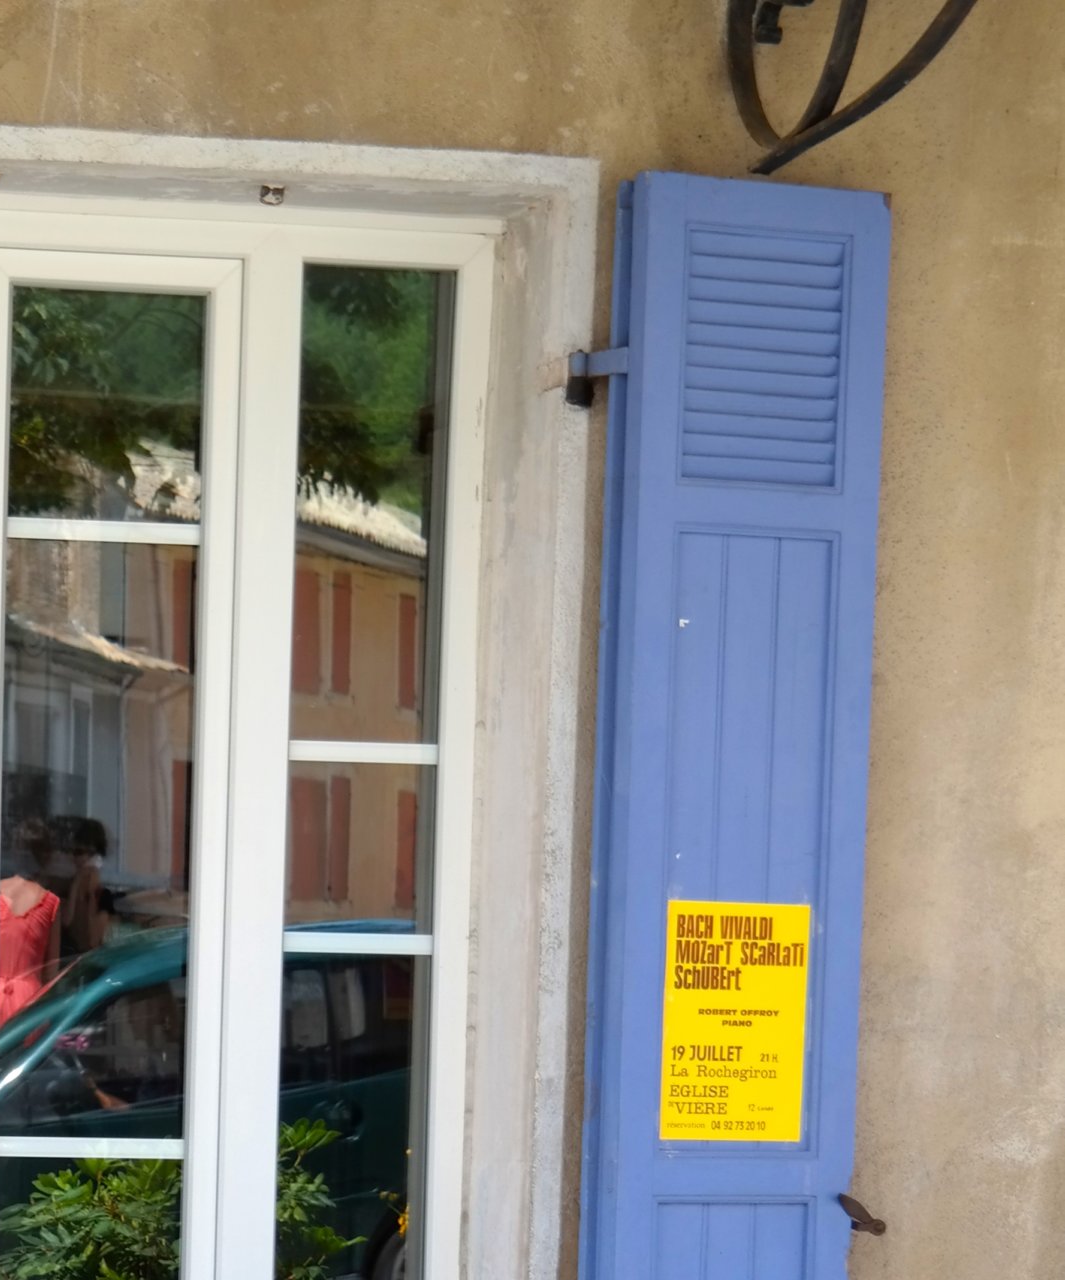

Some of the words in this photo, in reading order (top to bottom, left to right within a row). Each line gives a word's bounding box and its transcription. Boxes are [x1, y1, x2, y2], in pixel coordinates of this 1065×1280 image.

[677, 914, 714, 939] BACH
[720, 915, 773, 941] VIVALDI
[698, 1008, 738, 1016] ROBERT
[740, 1009, 779, 1017] OFFROY
[671, 1045, 685, 1061] 19
[689, 1045, 743, 1062] JUILLET
[760, 1053, 769, 1062] 21
[670, 1064, 689, 1077] La
[696, 1065, 777, 1082] Rochegiron
[711, 1121, 720, 1131] 04
[723, 1121, 733, 1131] 92
[746, 1121, 756, 1131] 20
[757, 1121, 766, 1131] 10
